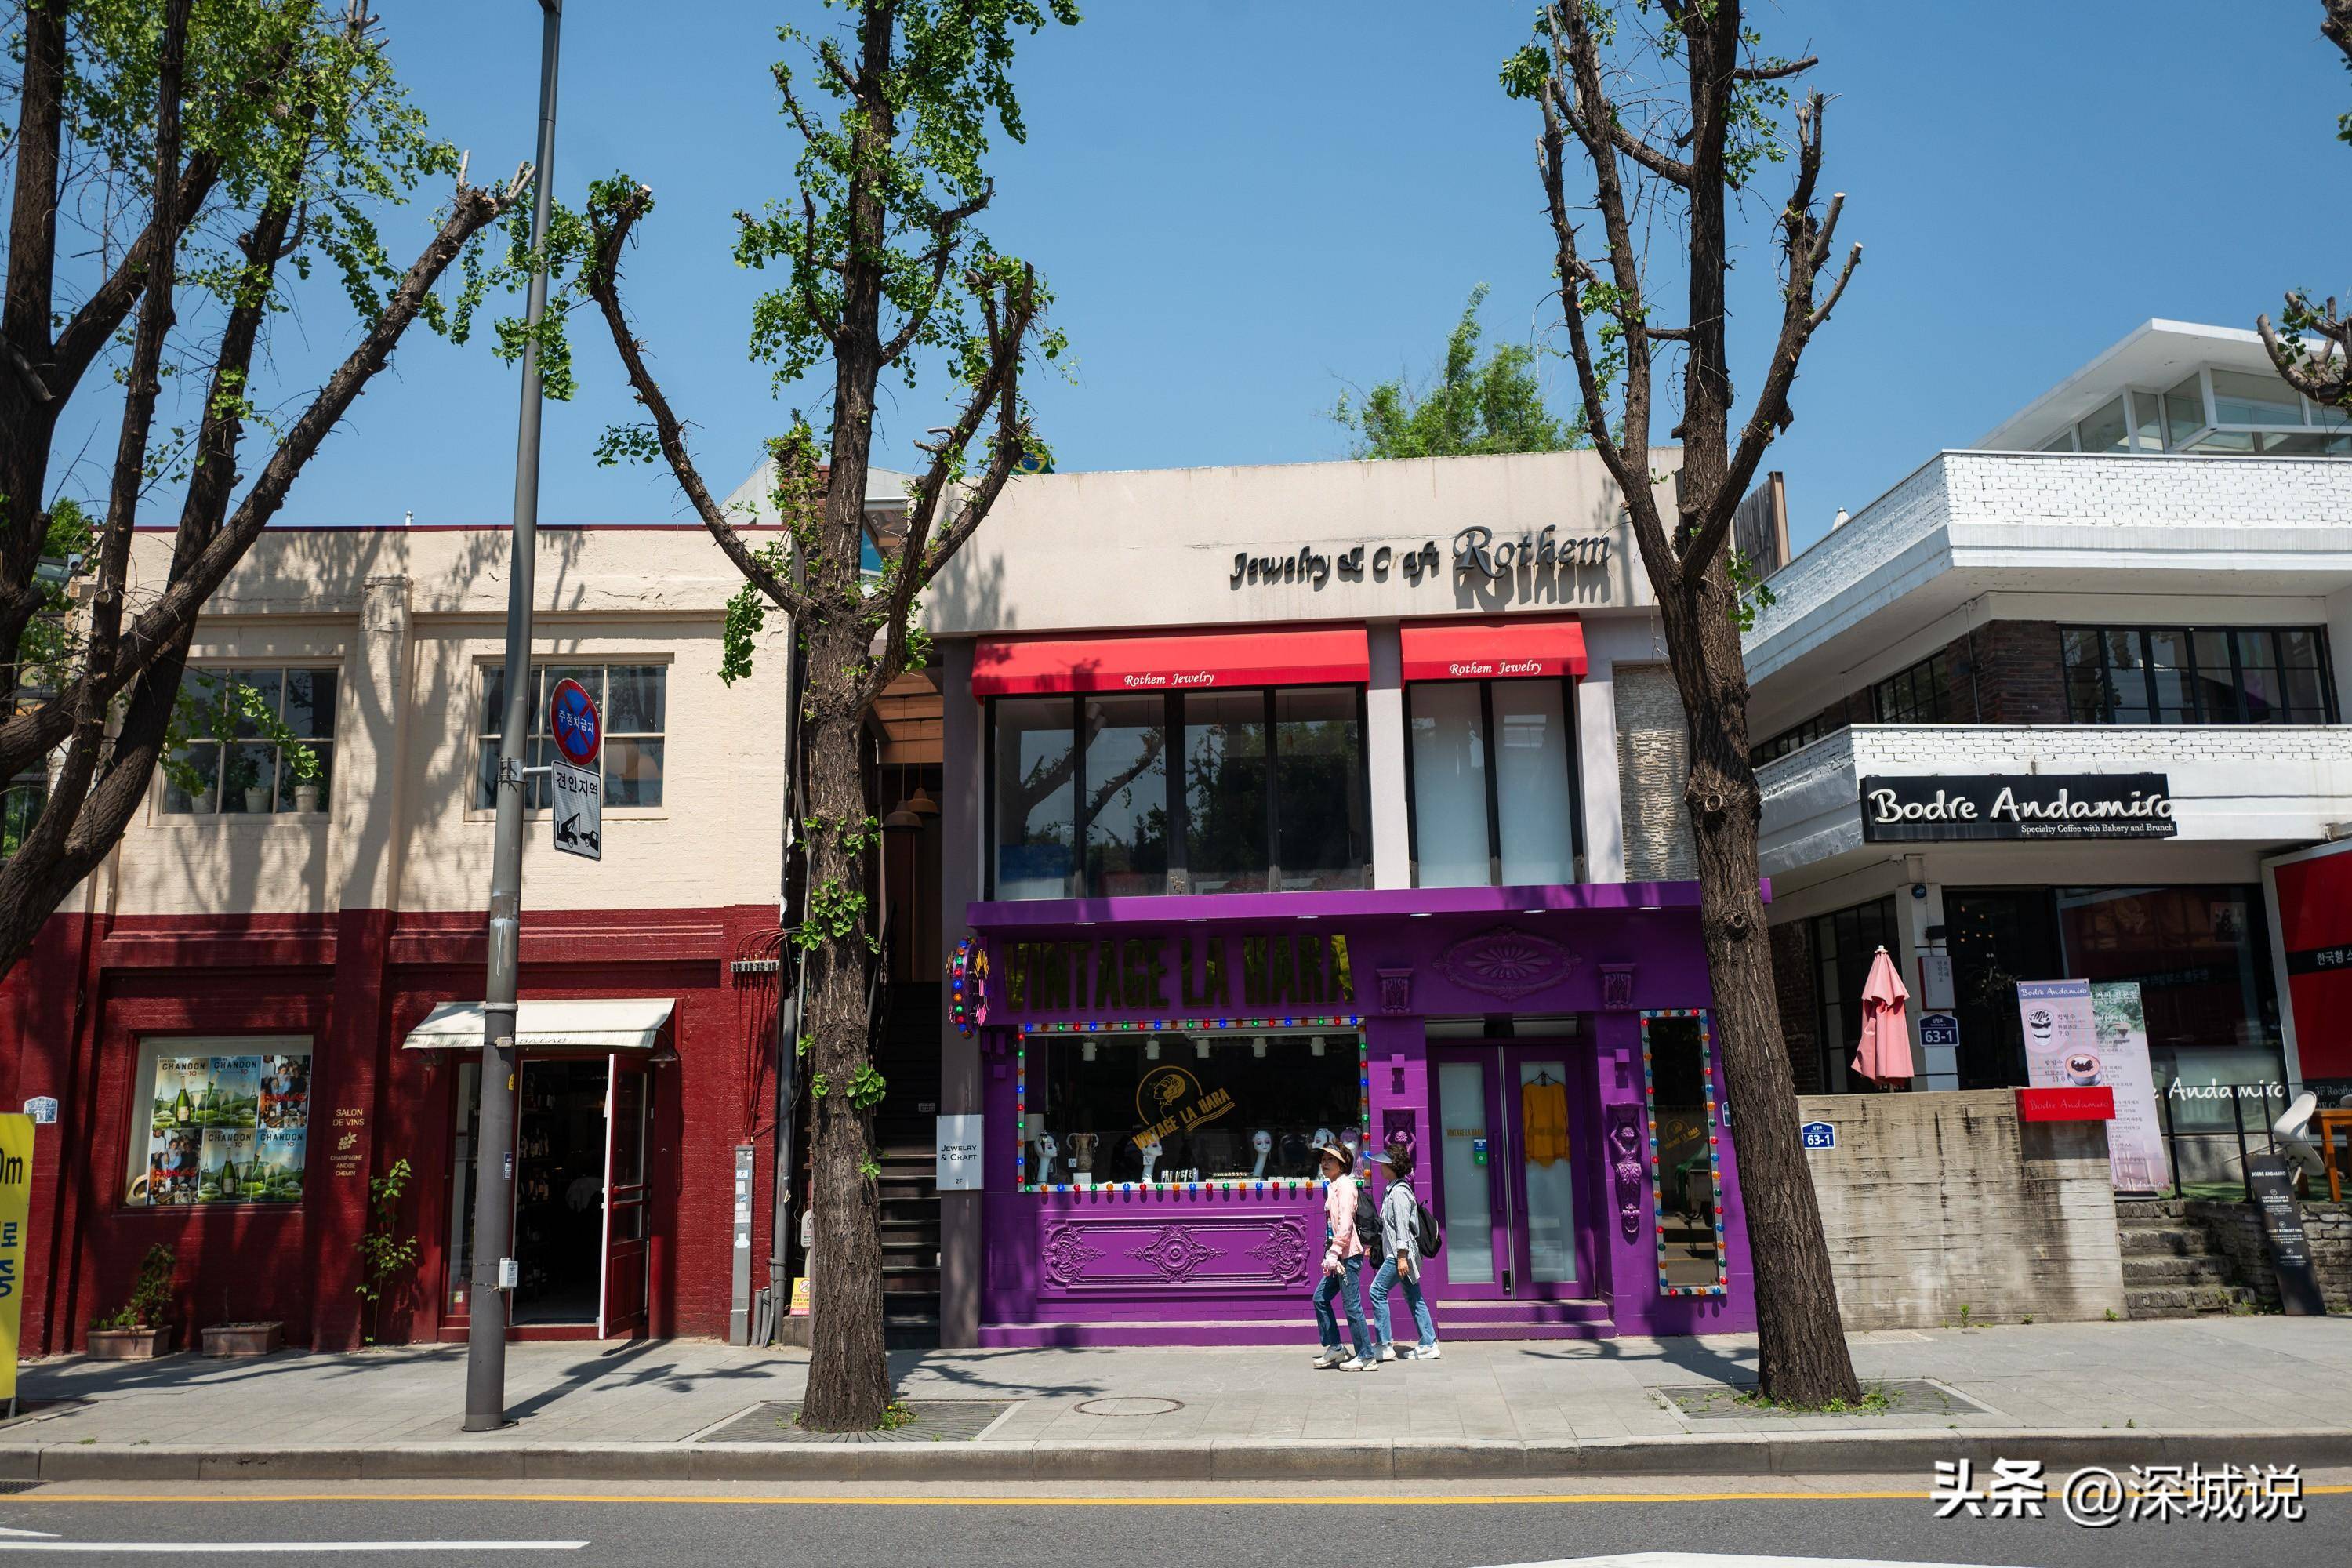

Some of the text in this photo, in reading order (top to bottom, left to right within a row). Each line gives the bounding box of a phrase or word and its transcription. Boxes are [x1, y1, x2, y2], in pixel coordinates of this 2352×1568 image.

[1230, 546, 1331, 582] Jewelry
[1338, 544, 1366, 573] &
[1453, 524, 1613, 579] Rothem
[1450, 660, 1542, 676] Rothem Jewelry
[1124, 671, 1214, 687] Rothem Jewelry
[558, 710, 595, 735] 주정차금지
[557, 771, 598, 800] 견인지역
[1869, 786, 2176, 823] Bodre Andamiro
[2021, 824, 2056, 834] Specialty
[2082, 824, 2100, 833] with
[2102, 824, 2129, 833] Bakery
[2146, 823, 2174, 832] Brunch
[2316, 949, 2344, 966] 한국형
[1003, 934, 1356, 1011] VINTAGE LA HARA
[2020, 987, 2087, 996] Bodre Andamiro
[1925, 1030, 1953, 1043] 63-1
[2029, 1099, 2056, 1111] Bodre
[1132, 1087, 1231, 1151] VINTAGE LA HARA
[1807, 1134, 1830, 1145] 63-1
